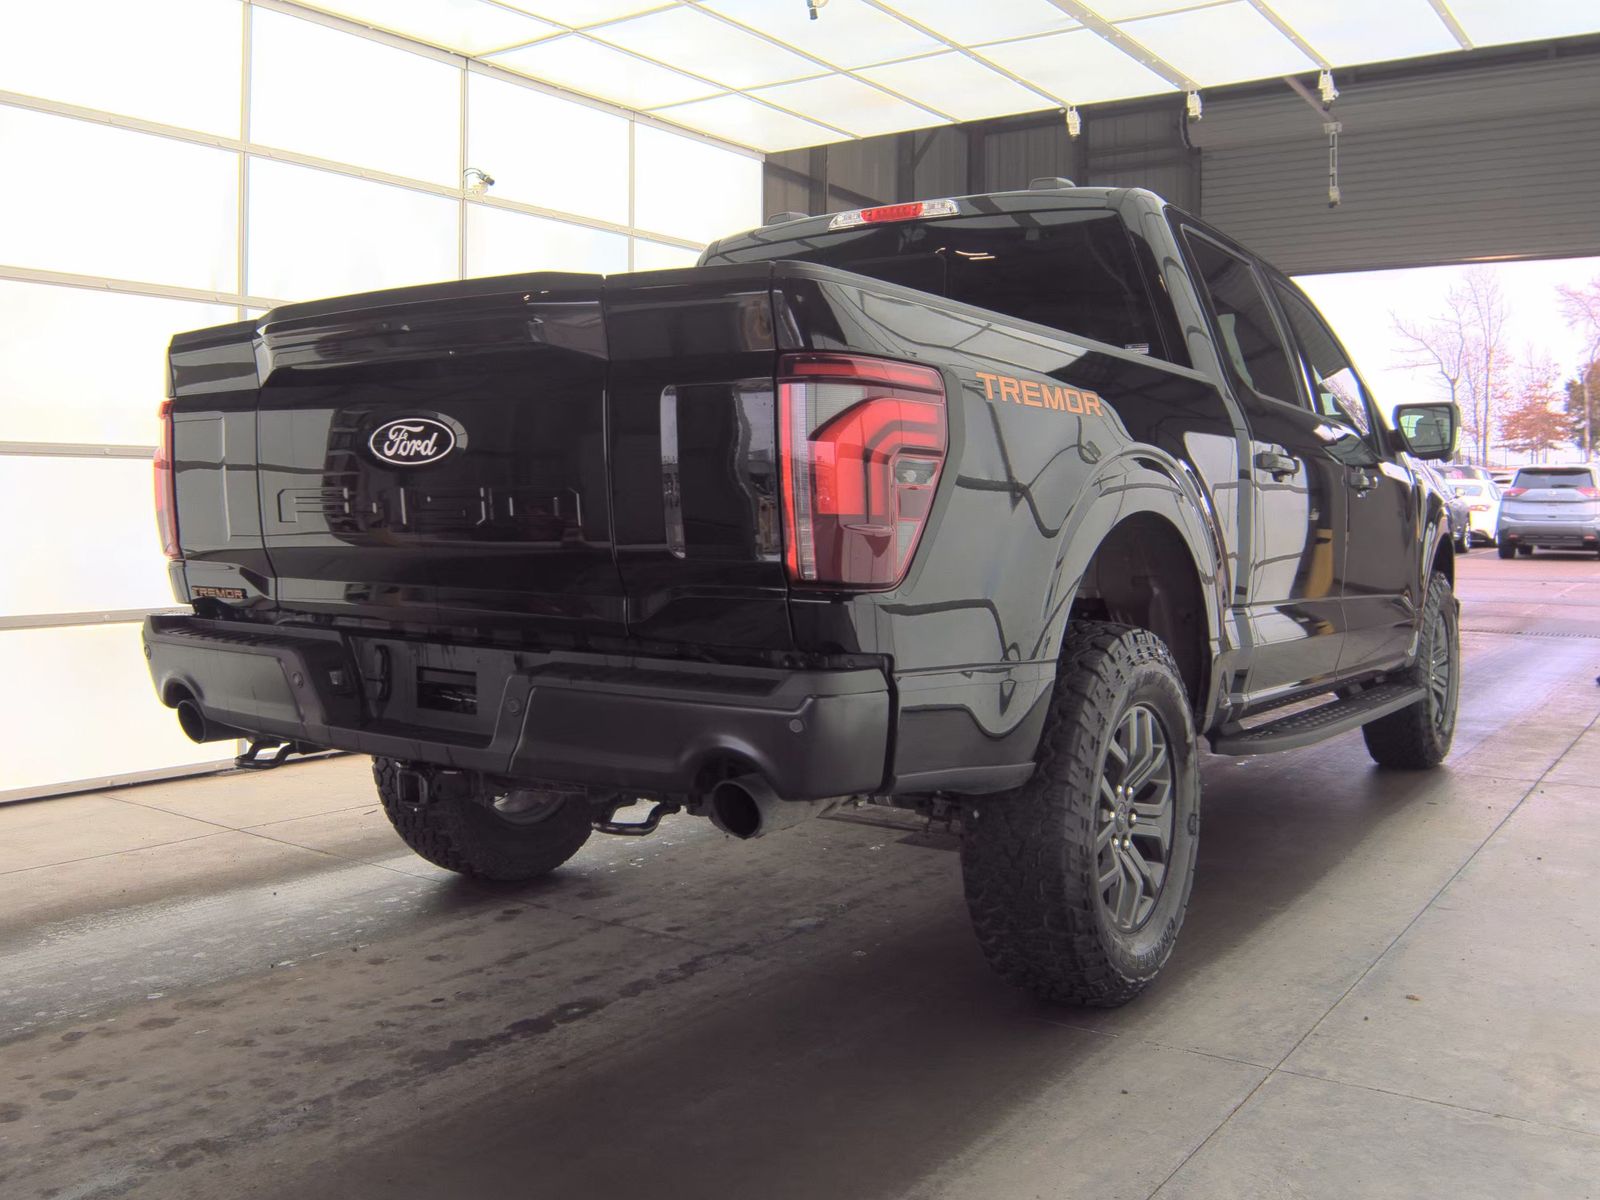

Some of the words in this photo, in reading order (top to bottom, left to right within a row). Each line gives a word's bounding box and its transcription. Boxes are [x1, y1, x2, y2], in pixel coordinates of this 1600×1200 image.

[975, 371, 1103, 417] TREMOR
[383, 424, 439, 456] Ford
[191, 586, 244, 599] TREMOR
